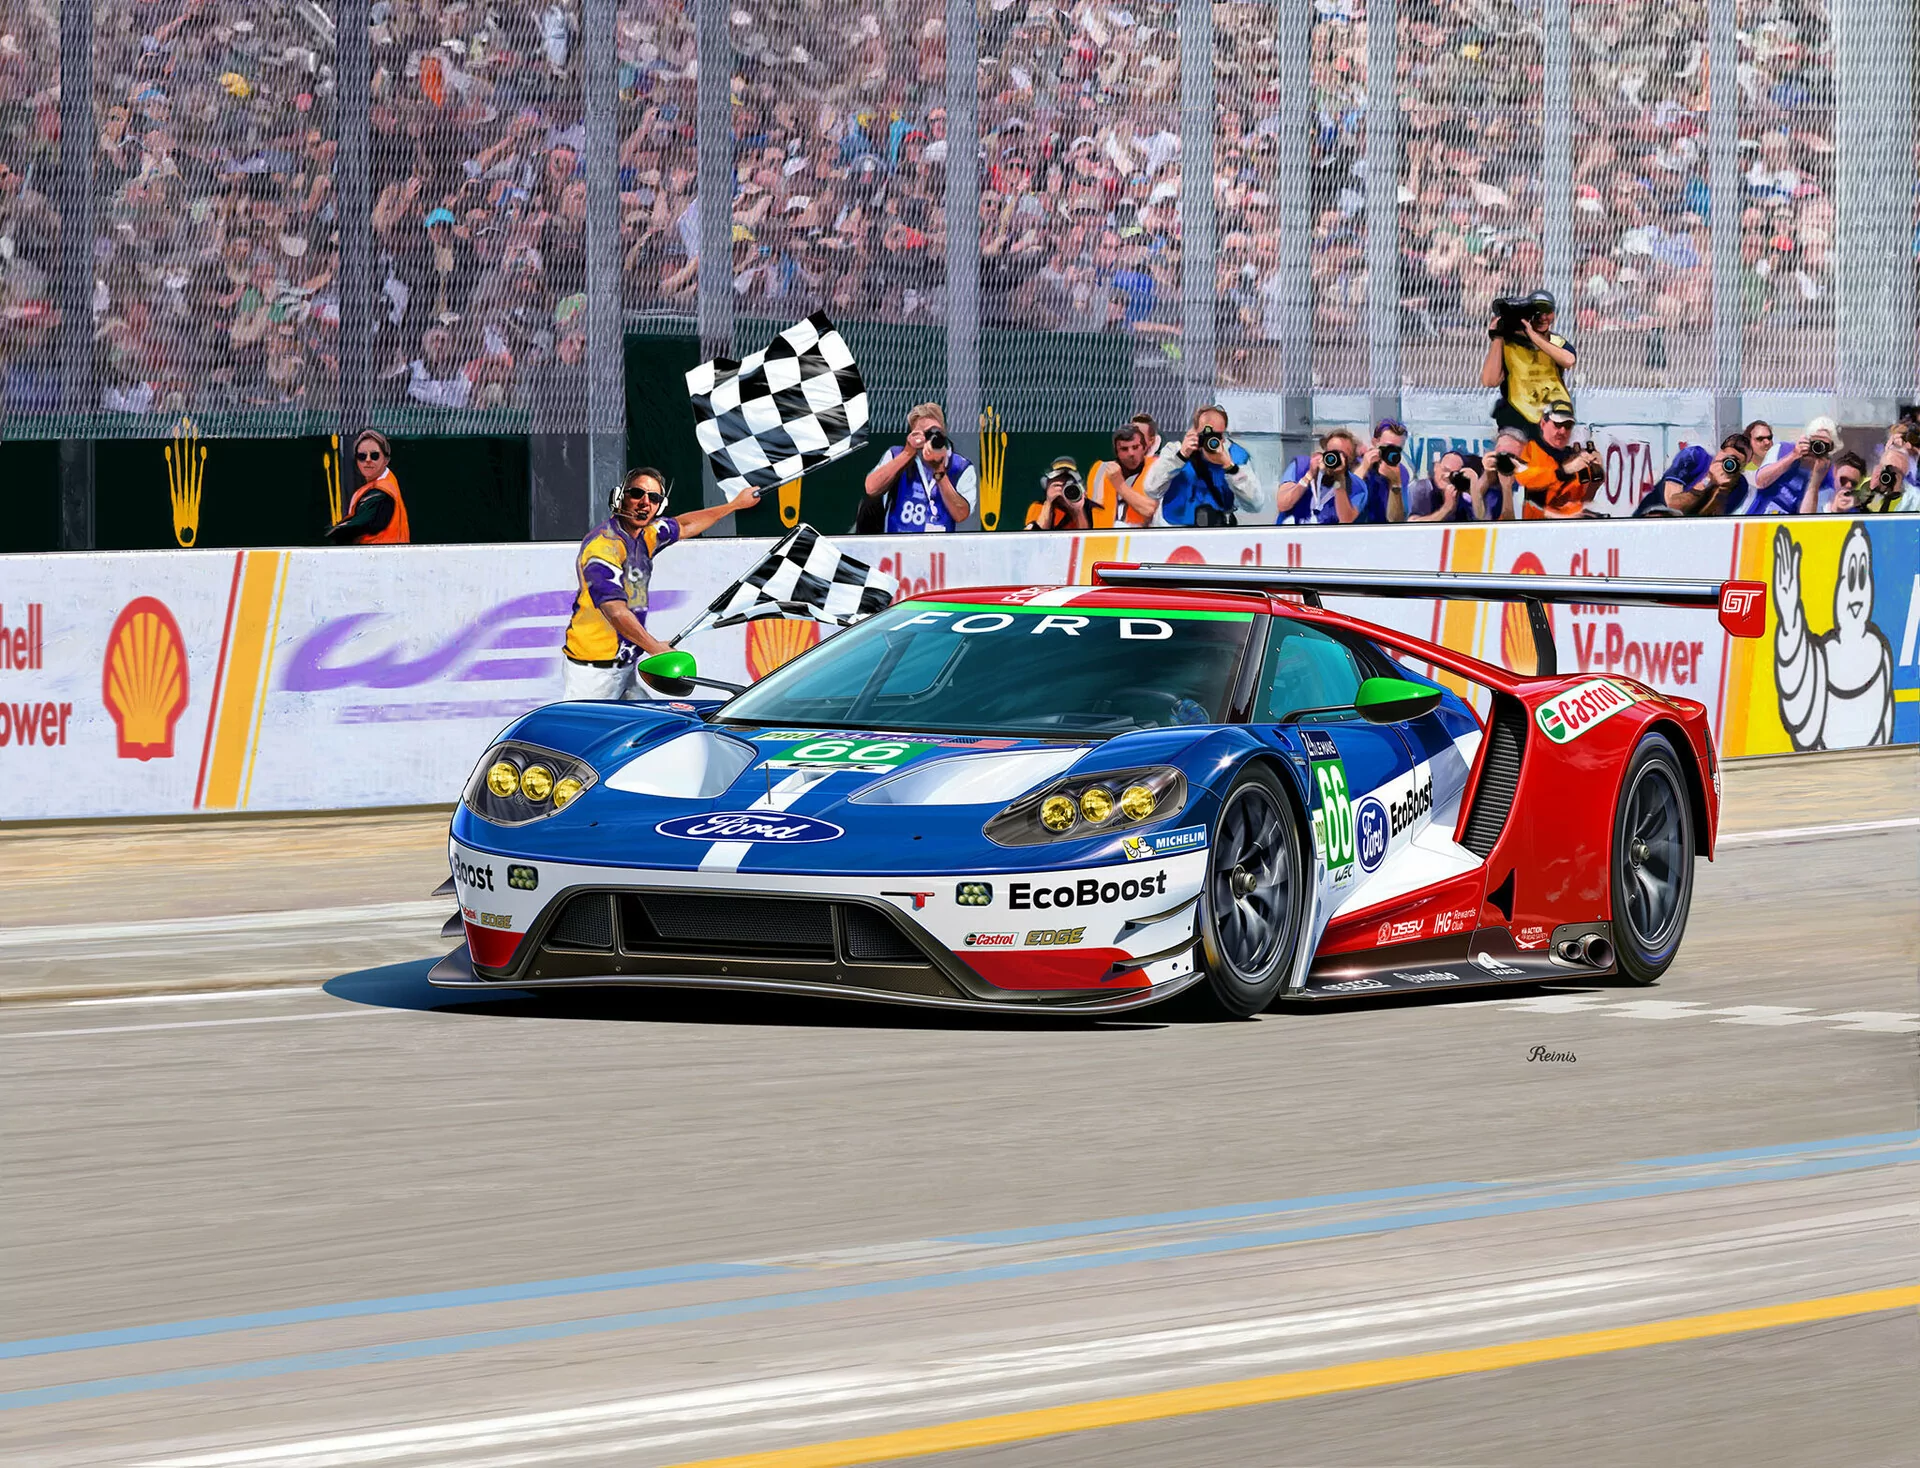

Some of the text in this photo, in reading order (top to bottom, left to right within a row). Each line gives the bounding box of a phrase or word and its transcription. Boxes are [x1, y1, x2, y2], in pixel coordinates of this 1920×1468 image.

[900, 500, 926, 526] 88
[1722, 589, 1763, 616] GT
[890, 611, 1175, 641] FORD
[1572, 622, 1704, 686] V-Power
[1558, 683, 1627, 730] Castrol
[793, 740, 911, 761] 66
[1317, 764, 1353, 863] 66
[1390, 775, 1434, 839] EcoBoost
[686, 814, 812, 840] Ford
[1155, 831, 1205, 849] MICHELIN
[1362, 808, 1385, 862] Ford
[1009, 869, 1168, 910] EcoBoost
[481, 912, 513, 929] EDGE
[1391, 918, 1425, 937] DSSV
[1433, 911, 1452, 935] IHG
[1451, 920, 1464, 931] Club
[976, 926, 1087, 946] Castrol EDGE
